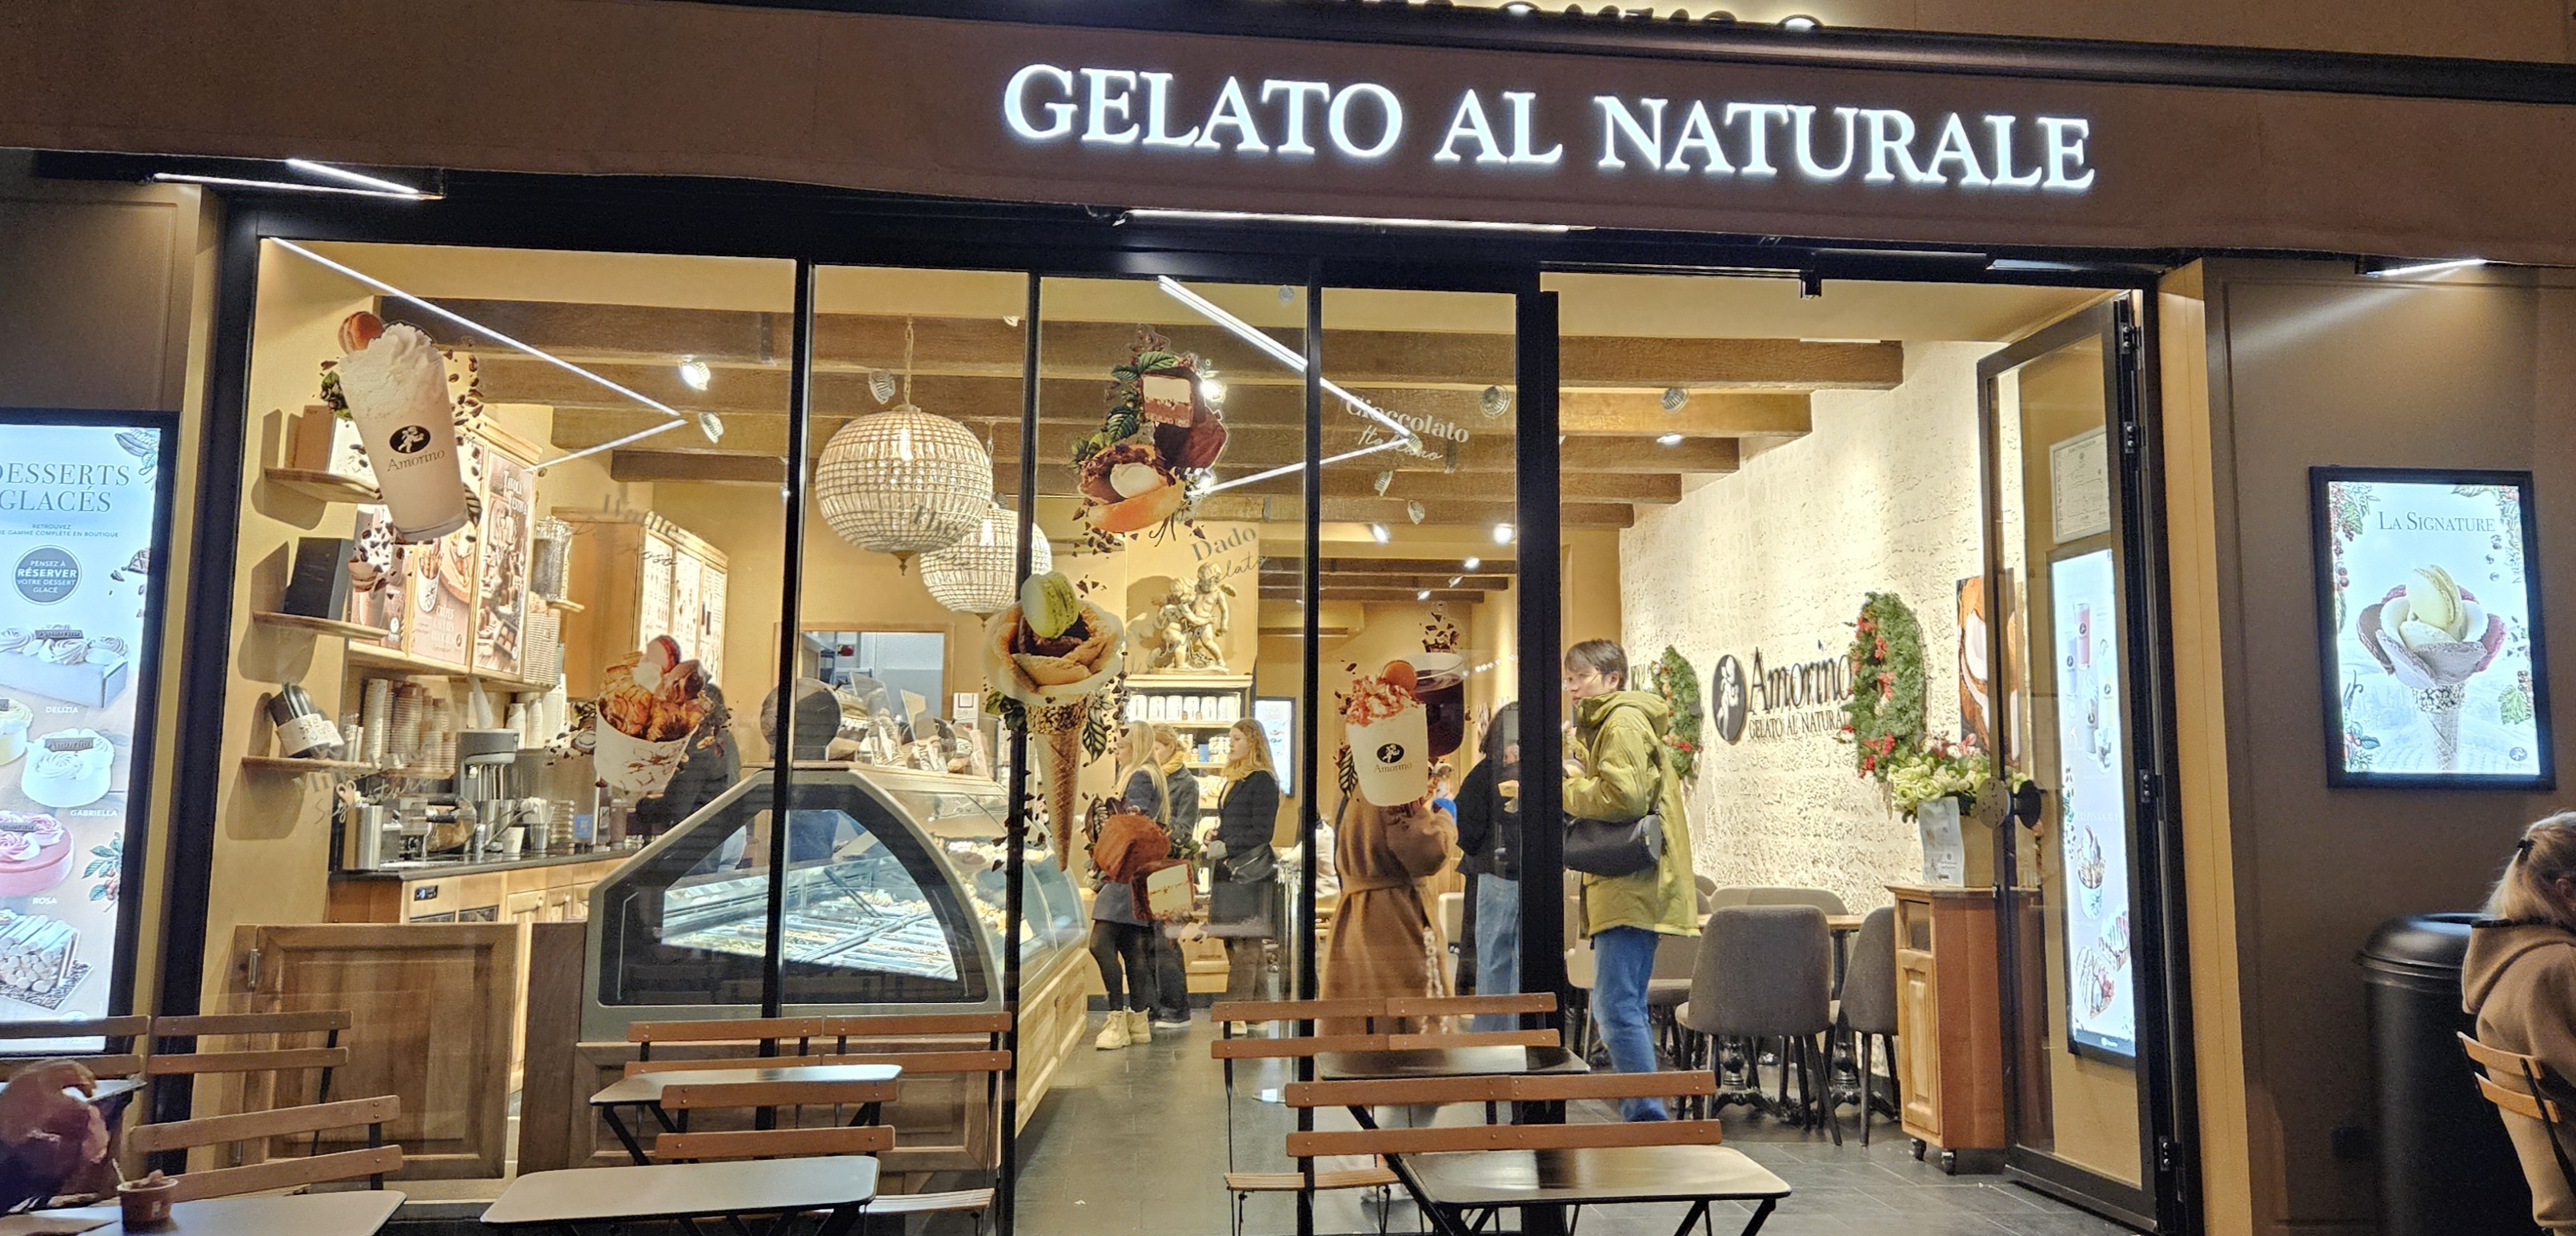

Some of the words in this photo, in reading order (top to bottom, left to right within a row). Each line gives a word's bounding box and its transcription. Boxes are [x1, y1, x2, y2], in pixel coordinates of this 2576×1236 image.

[1002, 62, 1403, 159] GELATO
[1434, 90, 1563, 165] AL
[1593, 94, 2097, 192] NATURALE
[1346, 395, 1469, 443] Cioccolato
[387, 450, 445, 472] Amorino
[0, 462, 130, 486] ESSERTS
[0, 486, 112, 512] GLACÉS
[1192, 528, 1256, 562] Dado
[18, 568, 78, 579] RÉSERVER
[33, 586, 58, 594] GLACÉ
[1748, 645, 1853, 715] Amorino
[1749, 717, 1784, 738] GELATO
[1786, 715, 1798, 736] AL
[1373, 762, 1412, 773] Amorino
[70, 809, 118, 817] GABRIELLA
